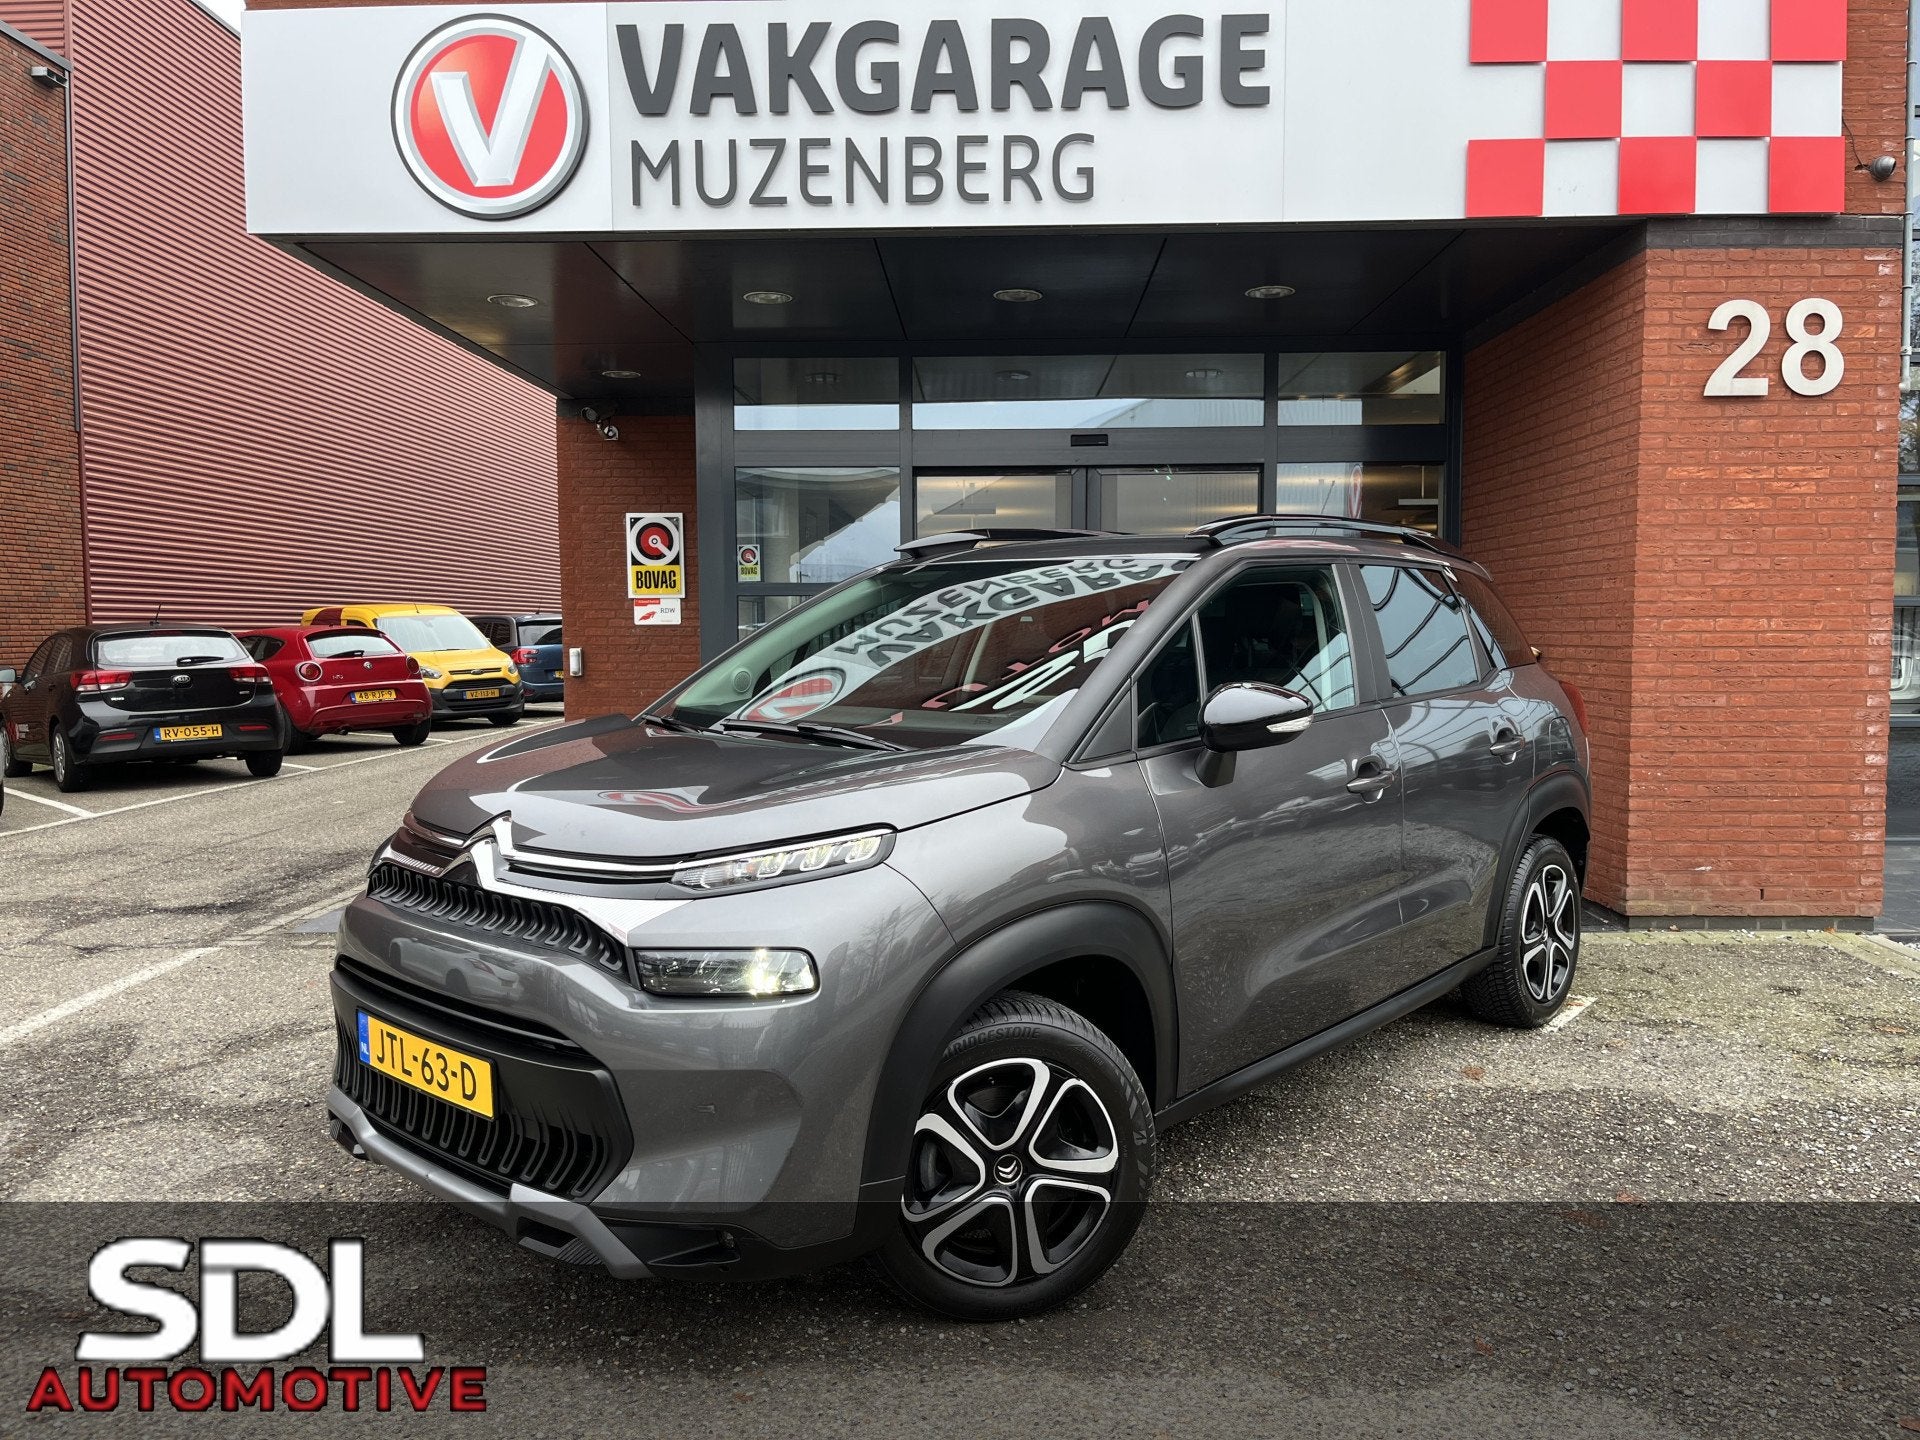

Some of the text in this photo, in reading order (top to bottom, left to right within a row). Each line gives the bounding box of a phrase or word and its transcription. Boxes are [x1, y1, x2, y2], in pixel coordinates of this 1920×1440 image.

[615, 13, 1270, 115] VAKGARAGE
[630, 132, 1095, 206] MUZENBERG
[1703, 297, 1845, 397] 28
[635, 570, 677, 589] BOVAG
[740, 566, 758, 575] BOVAG
[163, 725, 220, 739] RV-055-H
[376, 1028, 477, 1101] JTL-63-D
